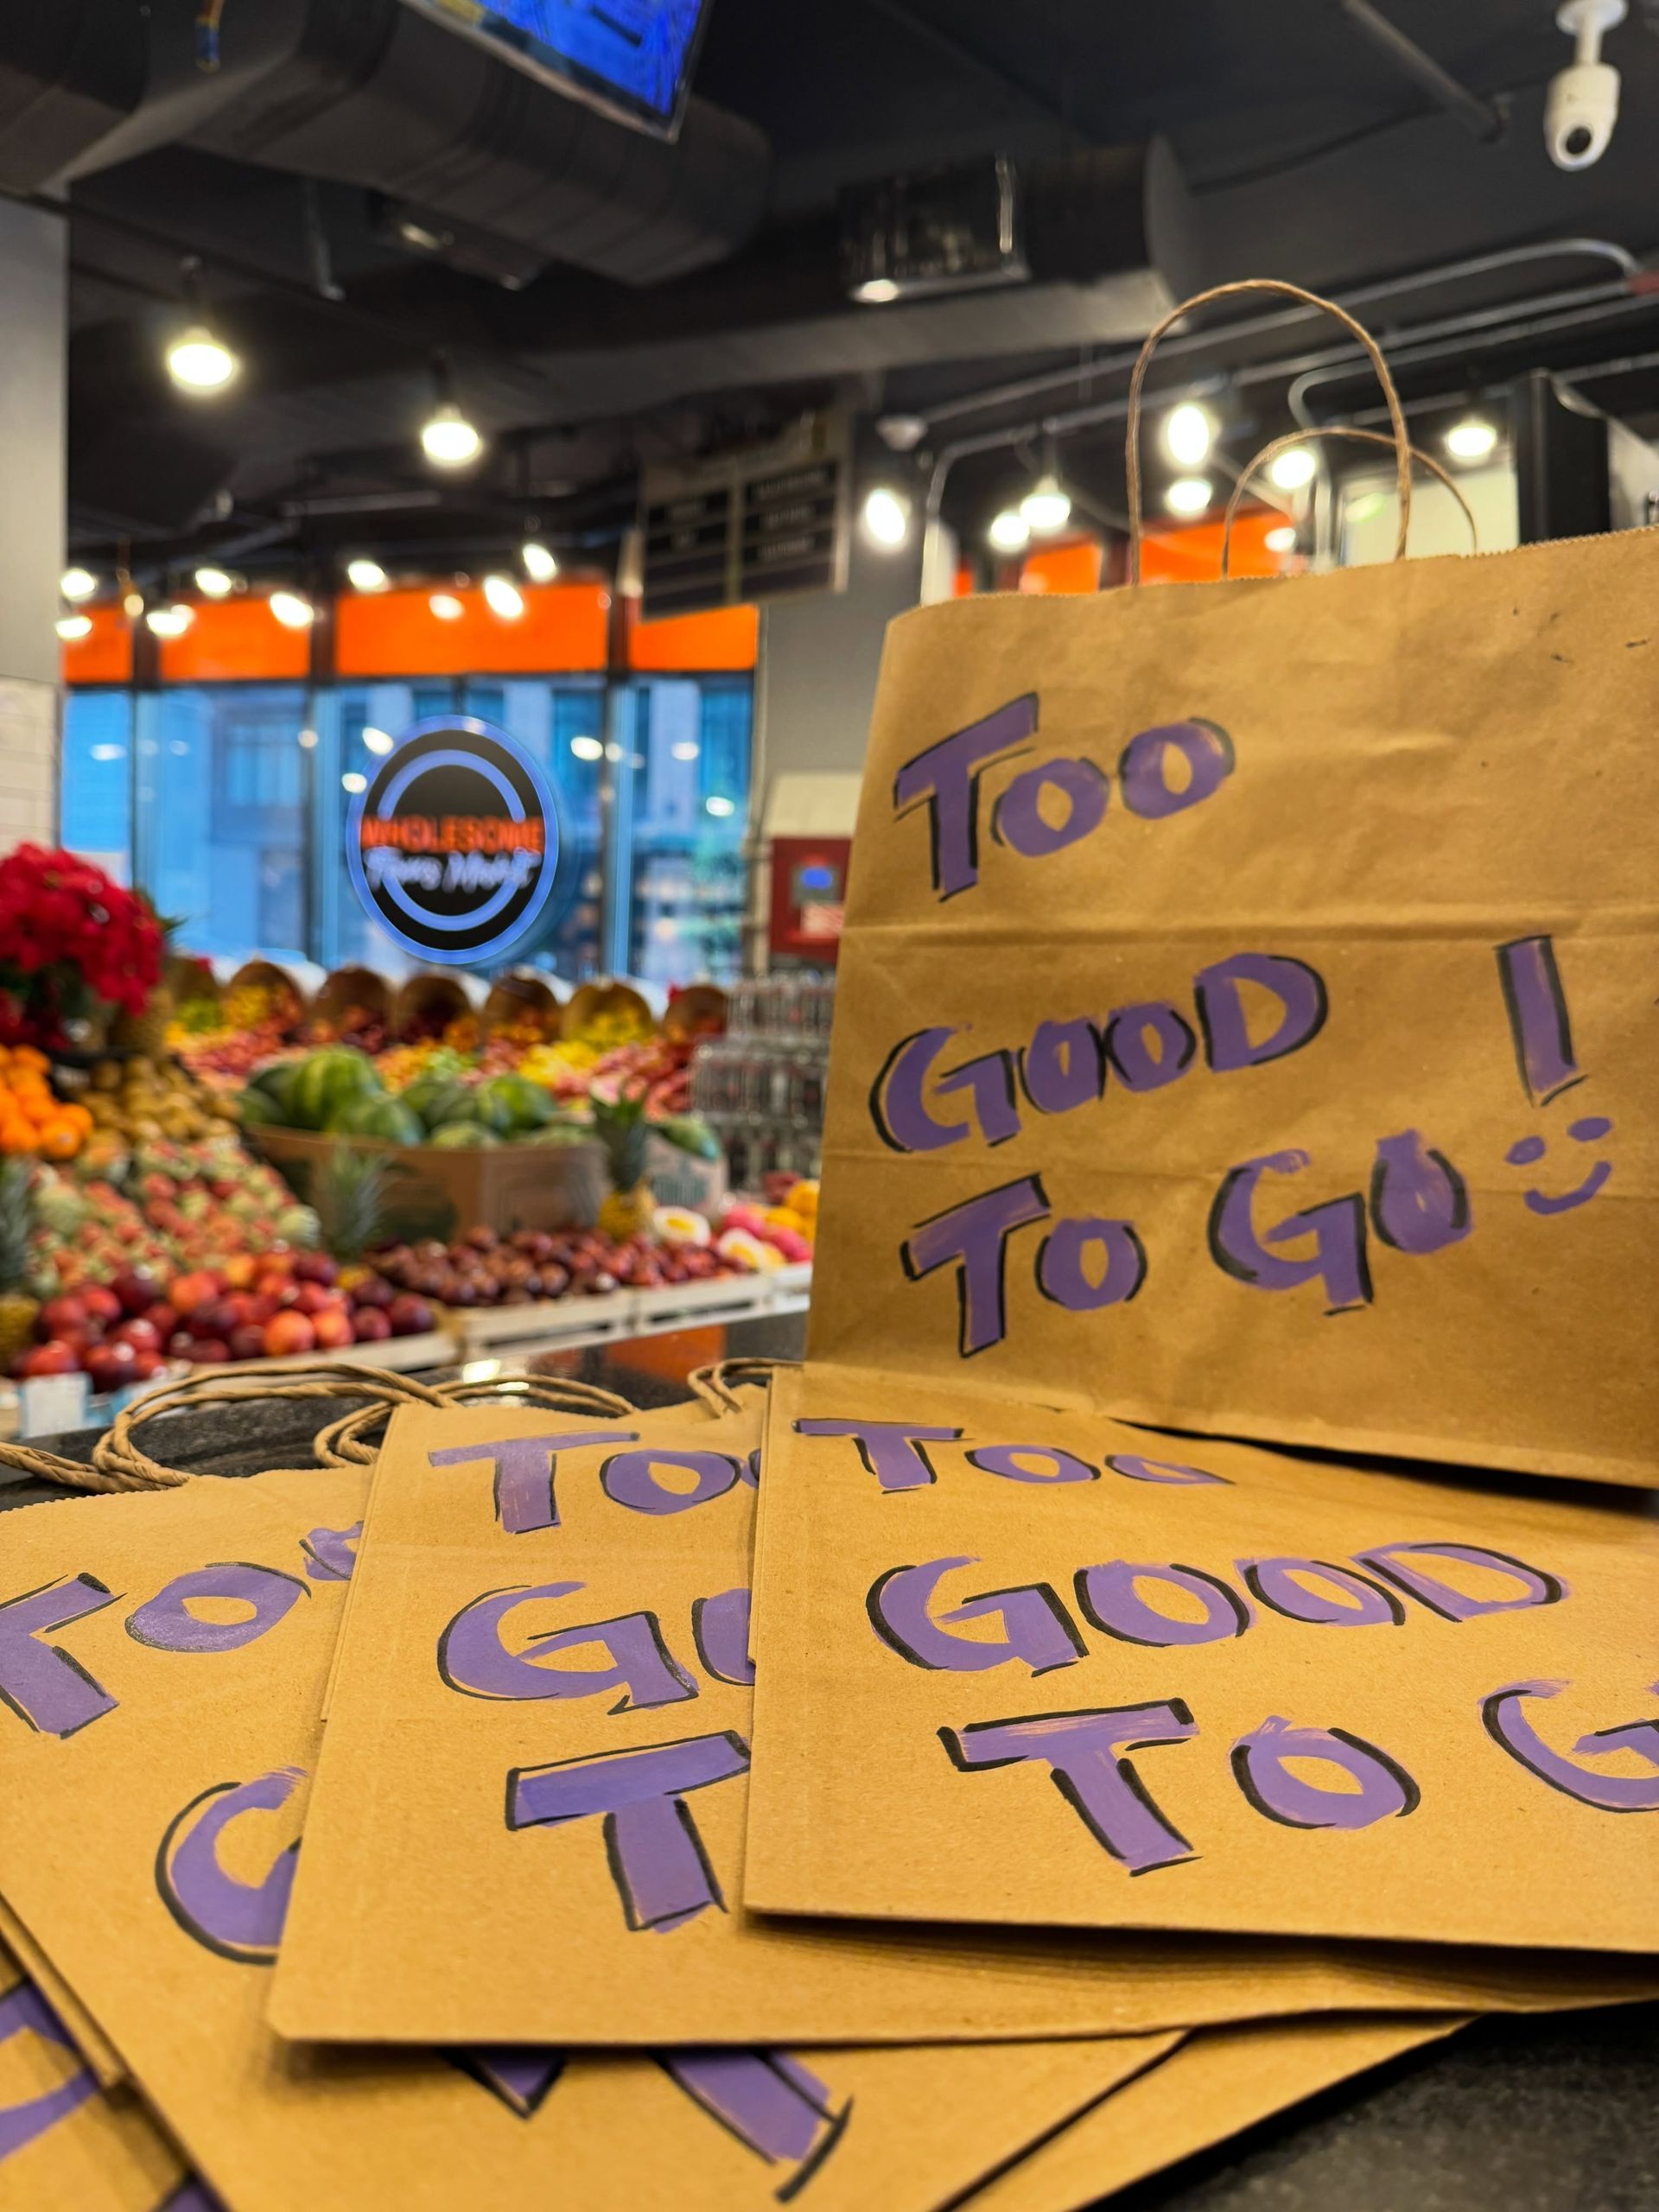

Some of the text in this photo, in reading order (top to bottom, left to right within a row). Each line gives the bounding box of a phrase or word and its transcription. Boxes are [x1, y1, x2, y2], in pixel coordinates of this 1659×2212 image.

[360, 815, 544, 853] WHOLESOME
[869, 934, 1589, 1153] GOOD !
[899, 1128, 1472, 1358] TO GO
[429, 1429, 761, 1534] TO
[866, 1541, 1569, 1677] GOOD
[936, 1678, 1659, 1877] TO G
